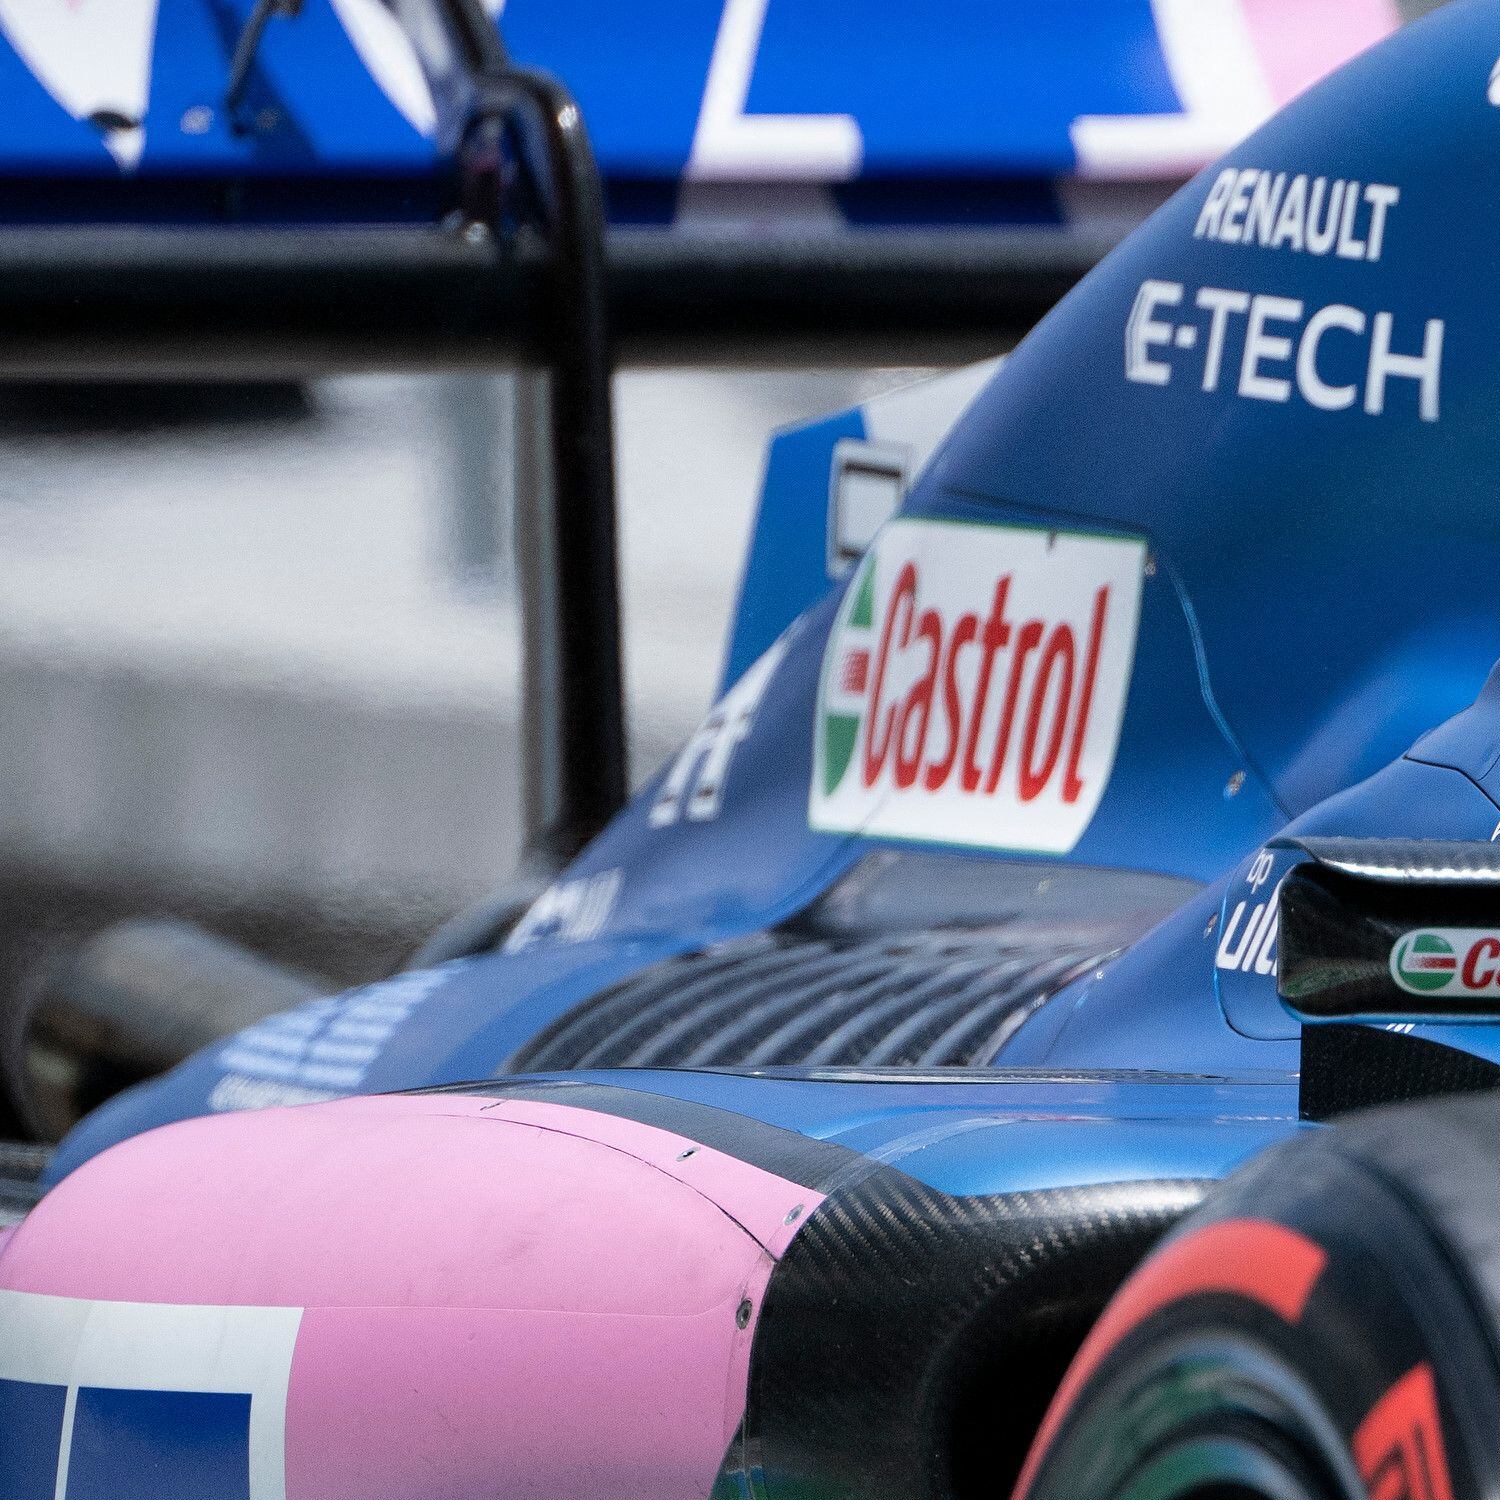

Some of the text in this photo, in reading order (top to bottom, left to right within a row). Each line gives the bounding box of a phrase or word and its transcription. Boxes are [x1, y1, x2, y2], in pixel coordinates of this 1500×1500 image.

[1195, 167, 1400, 262] RENAULT
[1125, 280, 1444, 422] E-TECH
[862, 562, 1112, 804] Castrol
